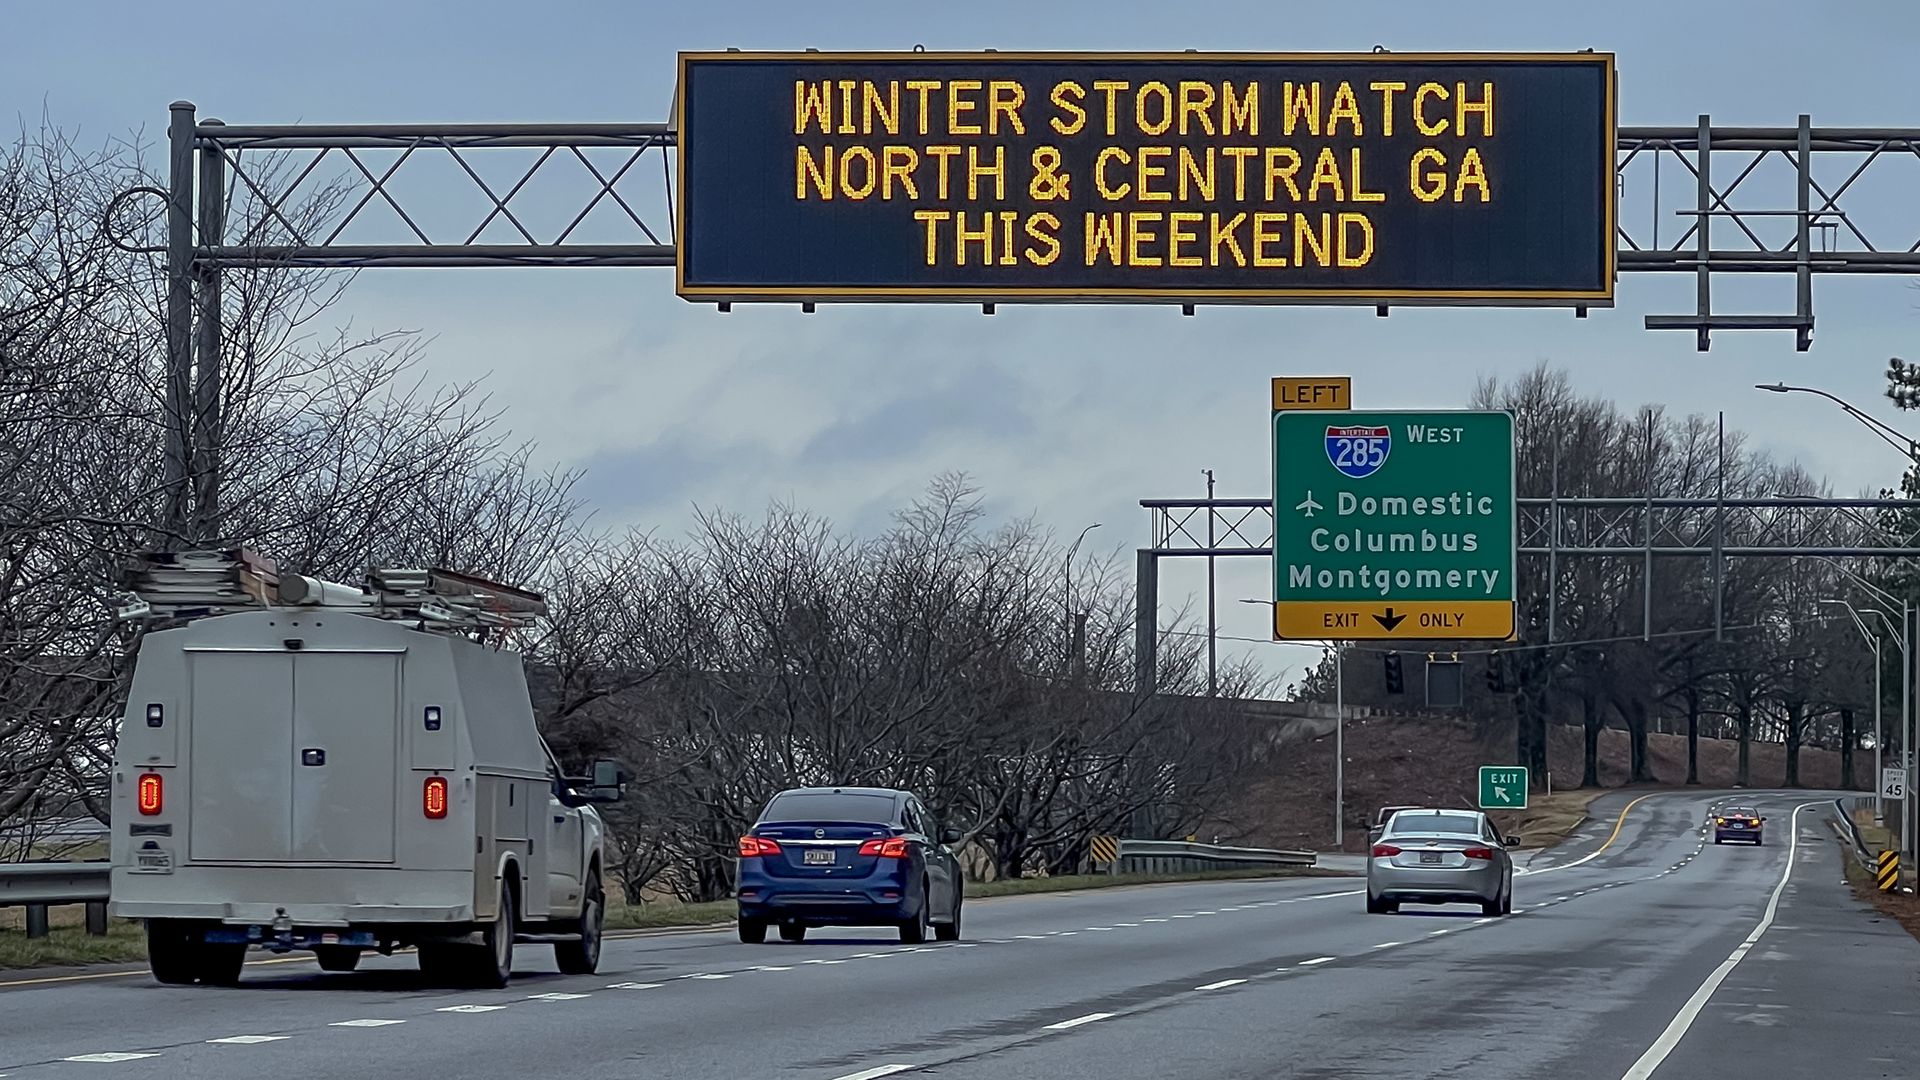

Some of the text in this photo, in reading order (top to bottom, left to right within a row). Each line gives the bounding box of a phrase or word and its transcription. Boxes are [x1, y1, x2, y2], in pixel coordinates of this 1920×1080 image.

[795, 80, 1494, 137] WINTER STORM WATCH
[796, 145, 1490, 202] NORTH & CENTRAL GA
[913, 210, 1374, 268] THIS WEEKEND
[1281, 385, 1341, 403] LEFT
[1406, 424, 1464, 443] WEST
[1336, 438, 1384, 467] 285
[1338, 491, 1493, 516] Domestic
[1310, 528, 1478, 552] Columbus
[1289, 564, 1499, 596] Montgomery
[1323, 613, 1465, 628] EXIT ONLY
[1491, 773, 1518, 784] EXIT
[1885, 784, 1902, 796] 45
